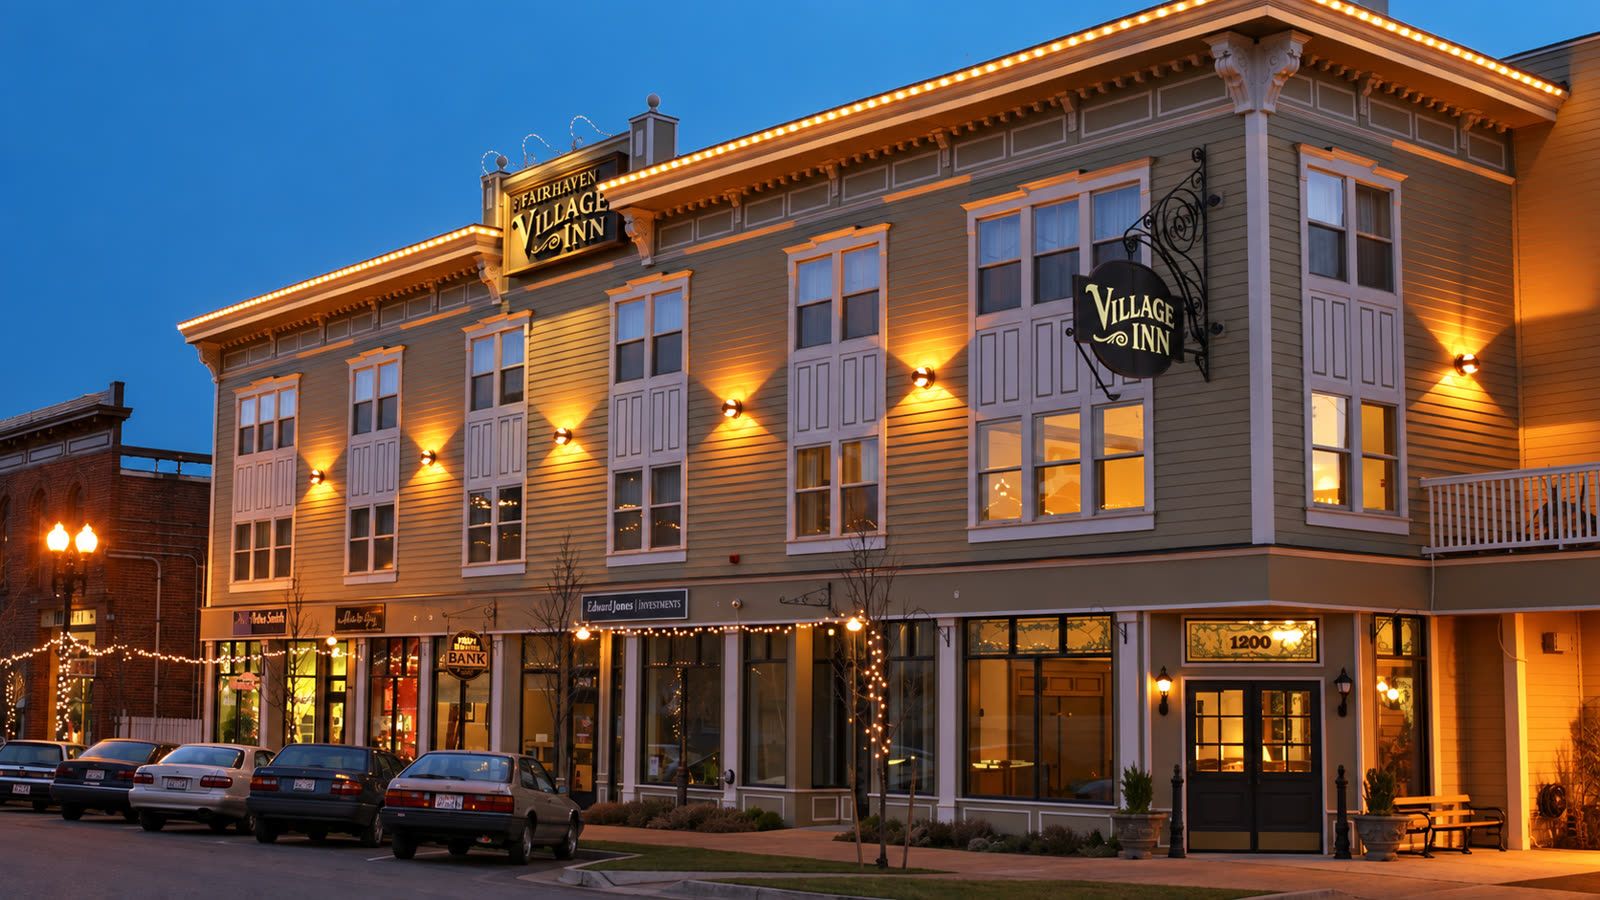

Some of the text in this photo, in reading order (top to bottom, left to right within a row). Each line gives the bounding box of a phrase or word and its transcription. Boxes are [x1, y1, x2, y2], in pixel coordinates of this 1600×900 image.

[521, 169, 597, 208] FAIRHAVEN
[512, 190, 608, 251] VILLAGE
[564, 216, 605, 249] INN
[1085, 283, 1175, 331] VILLAGE
[1132, 322, 1171, 356] INN
[587, 600, 612, 612] Edward
[612, 600, 633, 613] Jones
[448, 652, 486, 665] BANK
[1230, 635, 1272, 649] 1200
